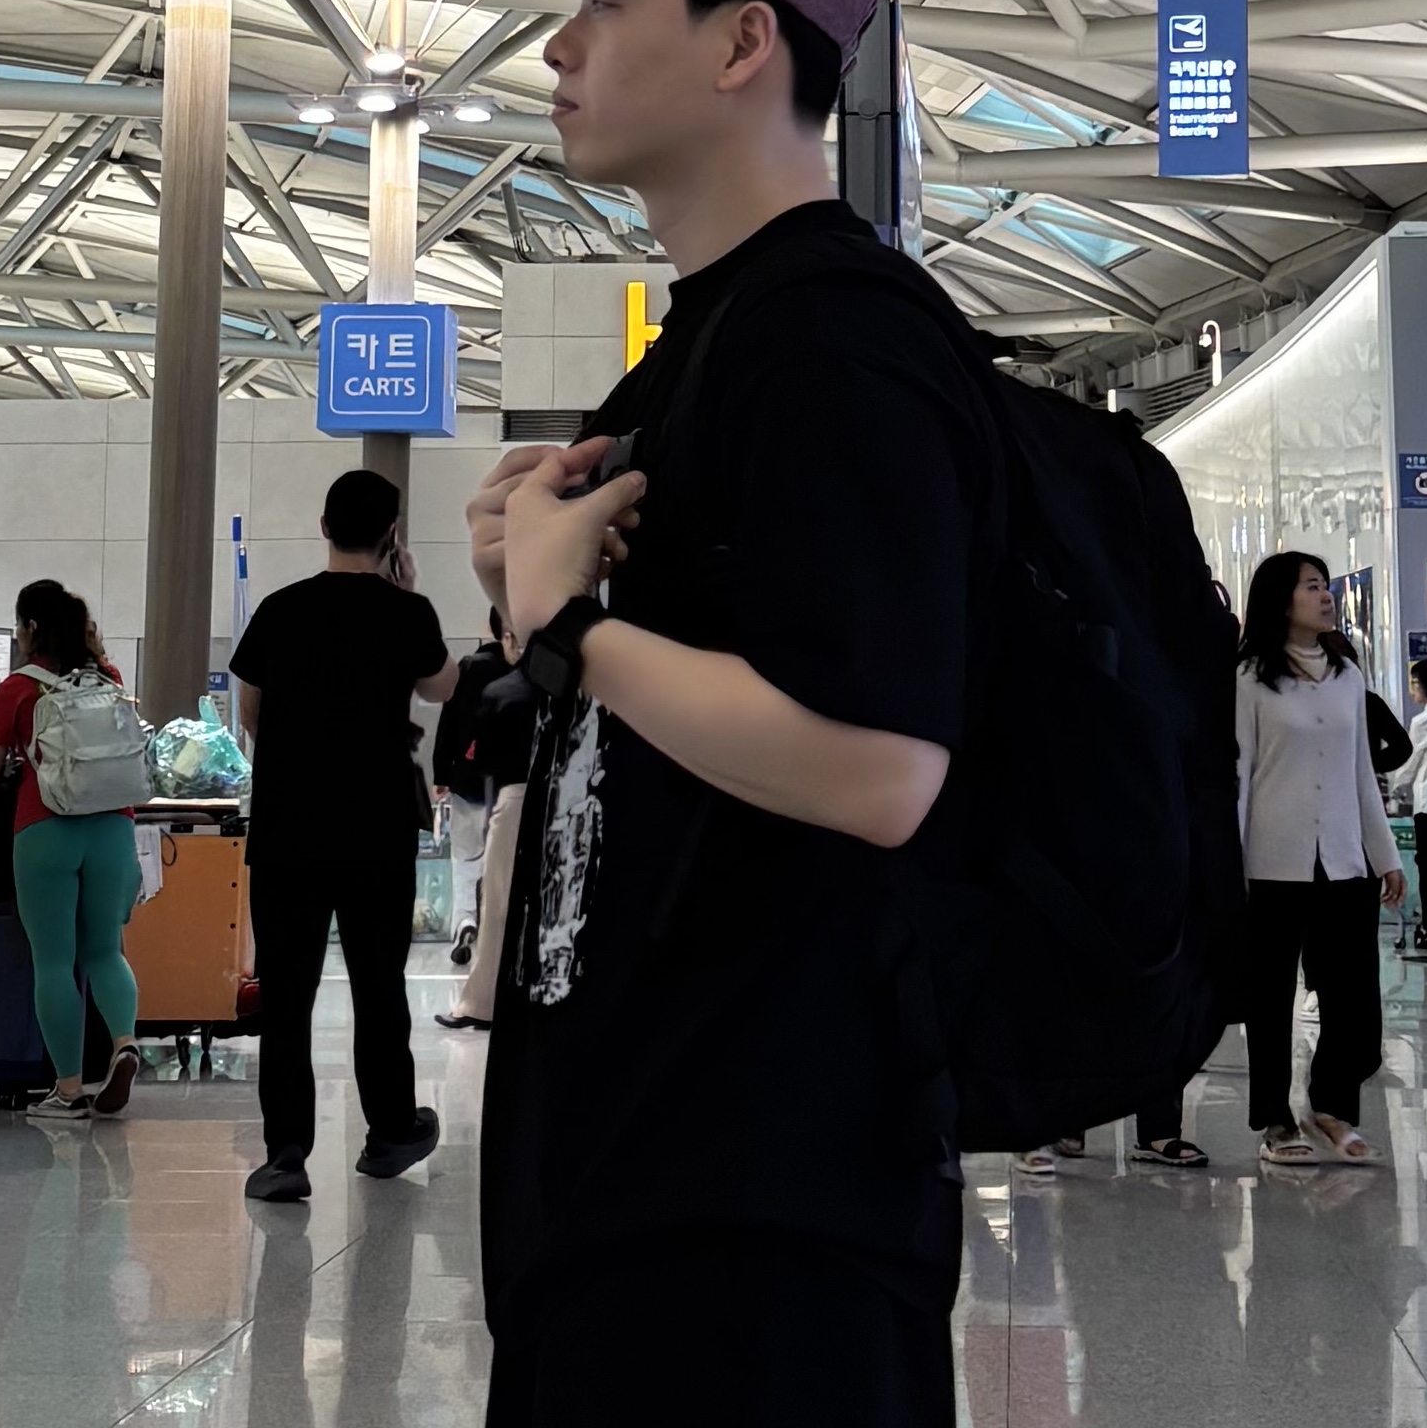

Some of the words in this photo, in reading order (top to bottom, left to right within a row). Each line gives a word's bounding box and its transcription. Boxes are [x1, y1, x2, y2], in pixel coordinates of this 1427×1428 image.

[1170, 111, 1237, 124] International
[1170, 125, 1218, 138] Boarding
[347, 334, 416, 370] 카트
[344, 377, 416, 396] CARTS
